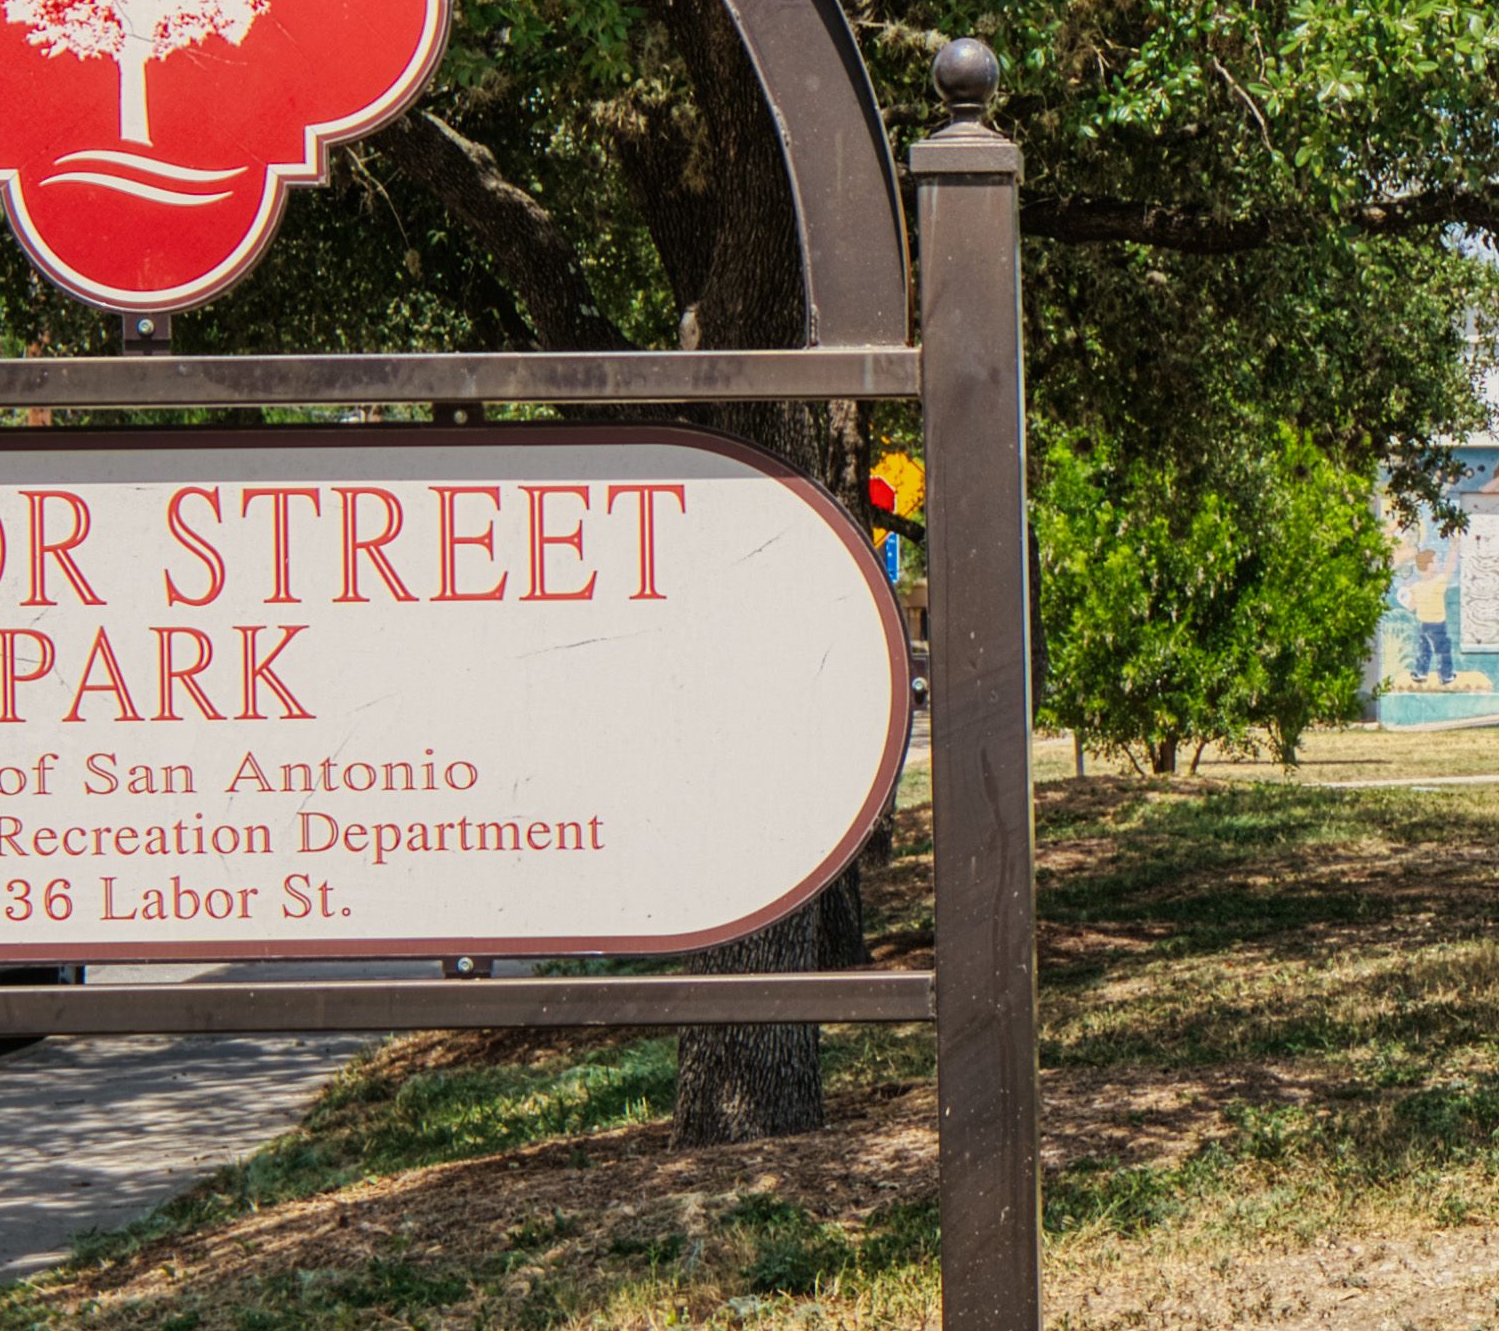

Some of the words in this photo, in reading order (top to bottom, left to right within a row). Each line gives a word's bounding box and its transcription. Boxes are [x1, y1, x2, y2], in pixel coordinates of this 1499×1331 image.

[163, 483, 687, 608] STREET
[83, 751, 195, 796] San
[226, 748, 479, 795] Antonio
[298, 811, 604, 867] Department
[99, 875, 259, 922] Labor
[281, 873, 352, 920] St.
